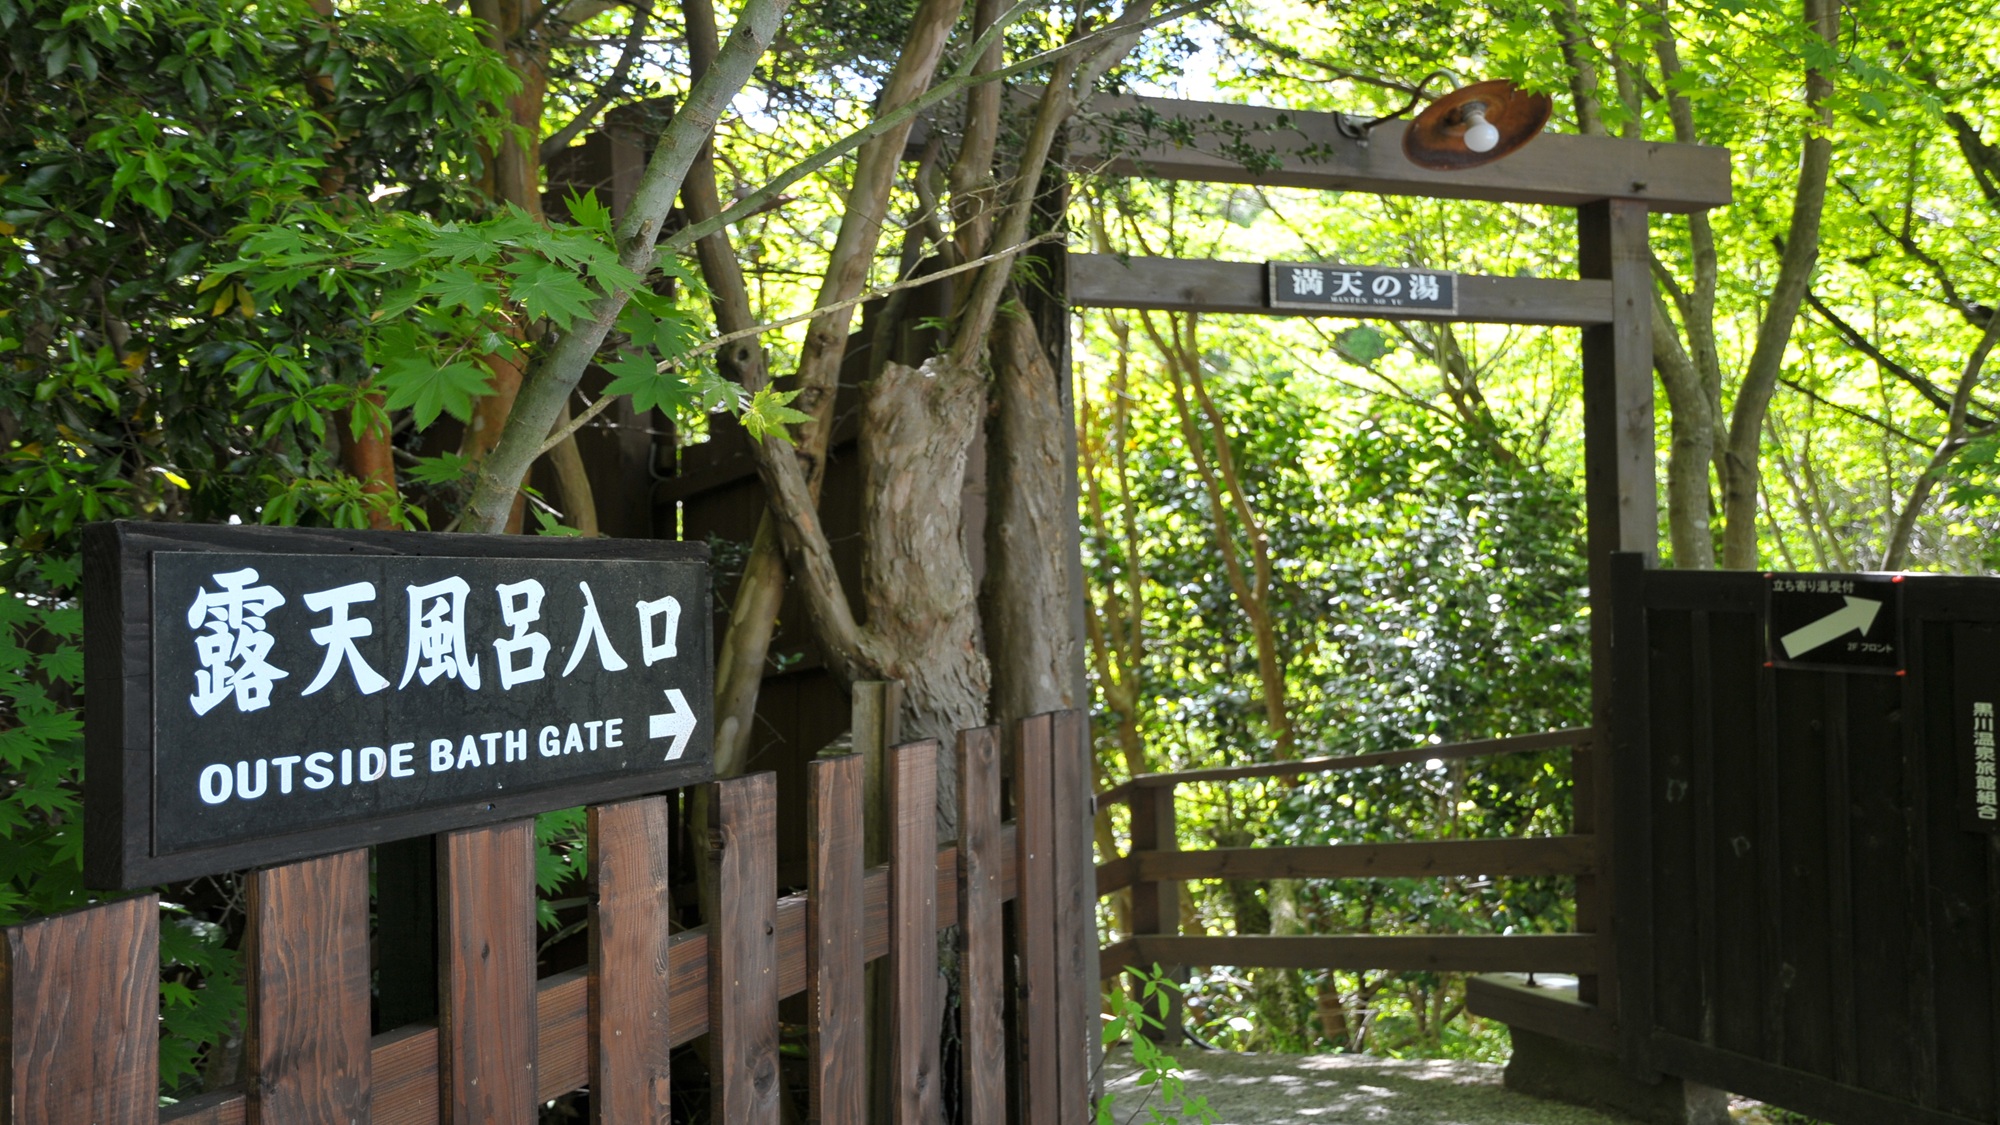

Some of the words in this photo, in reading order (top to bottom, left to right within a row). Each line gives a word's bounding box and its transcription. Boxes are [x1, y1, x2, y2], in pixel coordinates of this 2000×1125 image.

[1291, 268, 1440, 301] 満天の湯
[1330, 296, 1367, 305] MANTEN
[1773, 579, 1854, 593] 立ち寄り湯受付
[187, 567, 681, 716] 露天風呂入口
[1861, 643, 1893, 653] フロント
[199, 742, 415, 804] OUTSIDE
[430, 728, 527, 772] BATH
[538, 717, 623, 758] GATE
[1973, 702, 1997, 820] 黒川温泉旅館組合
